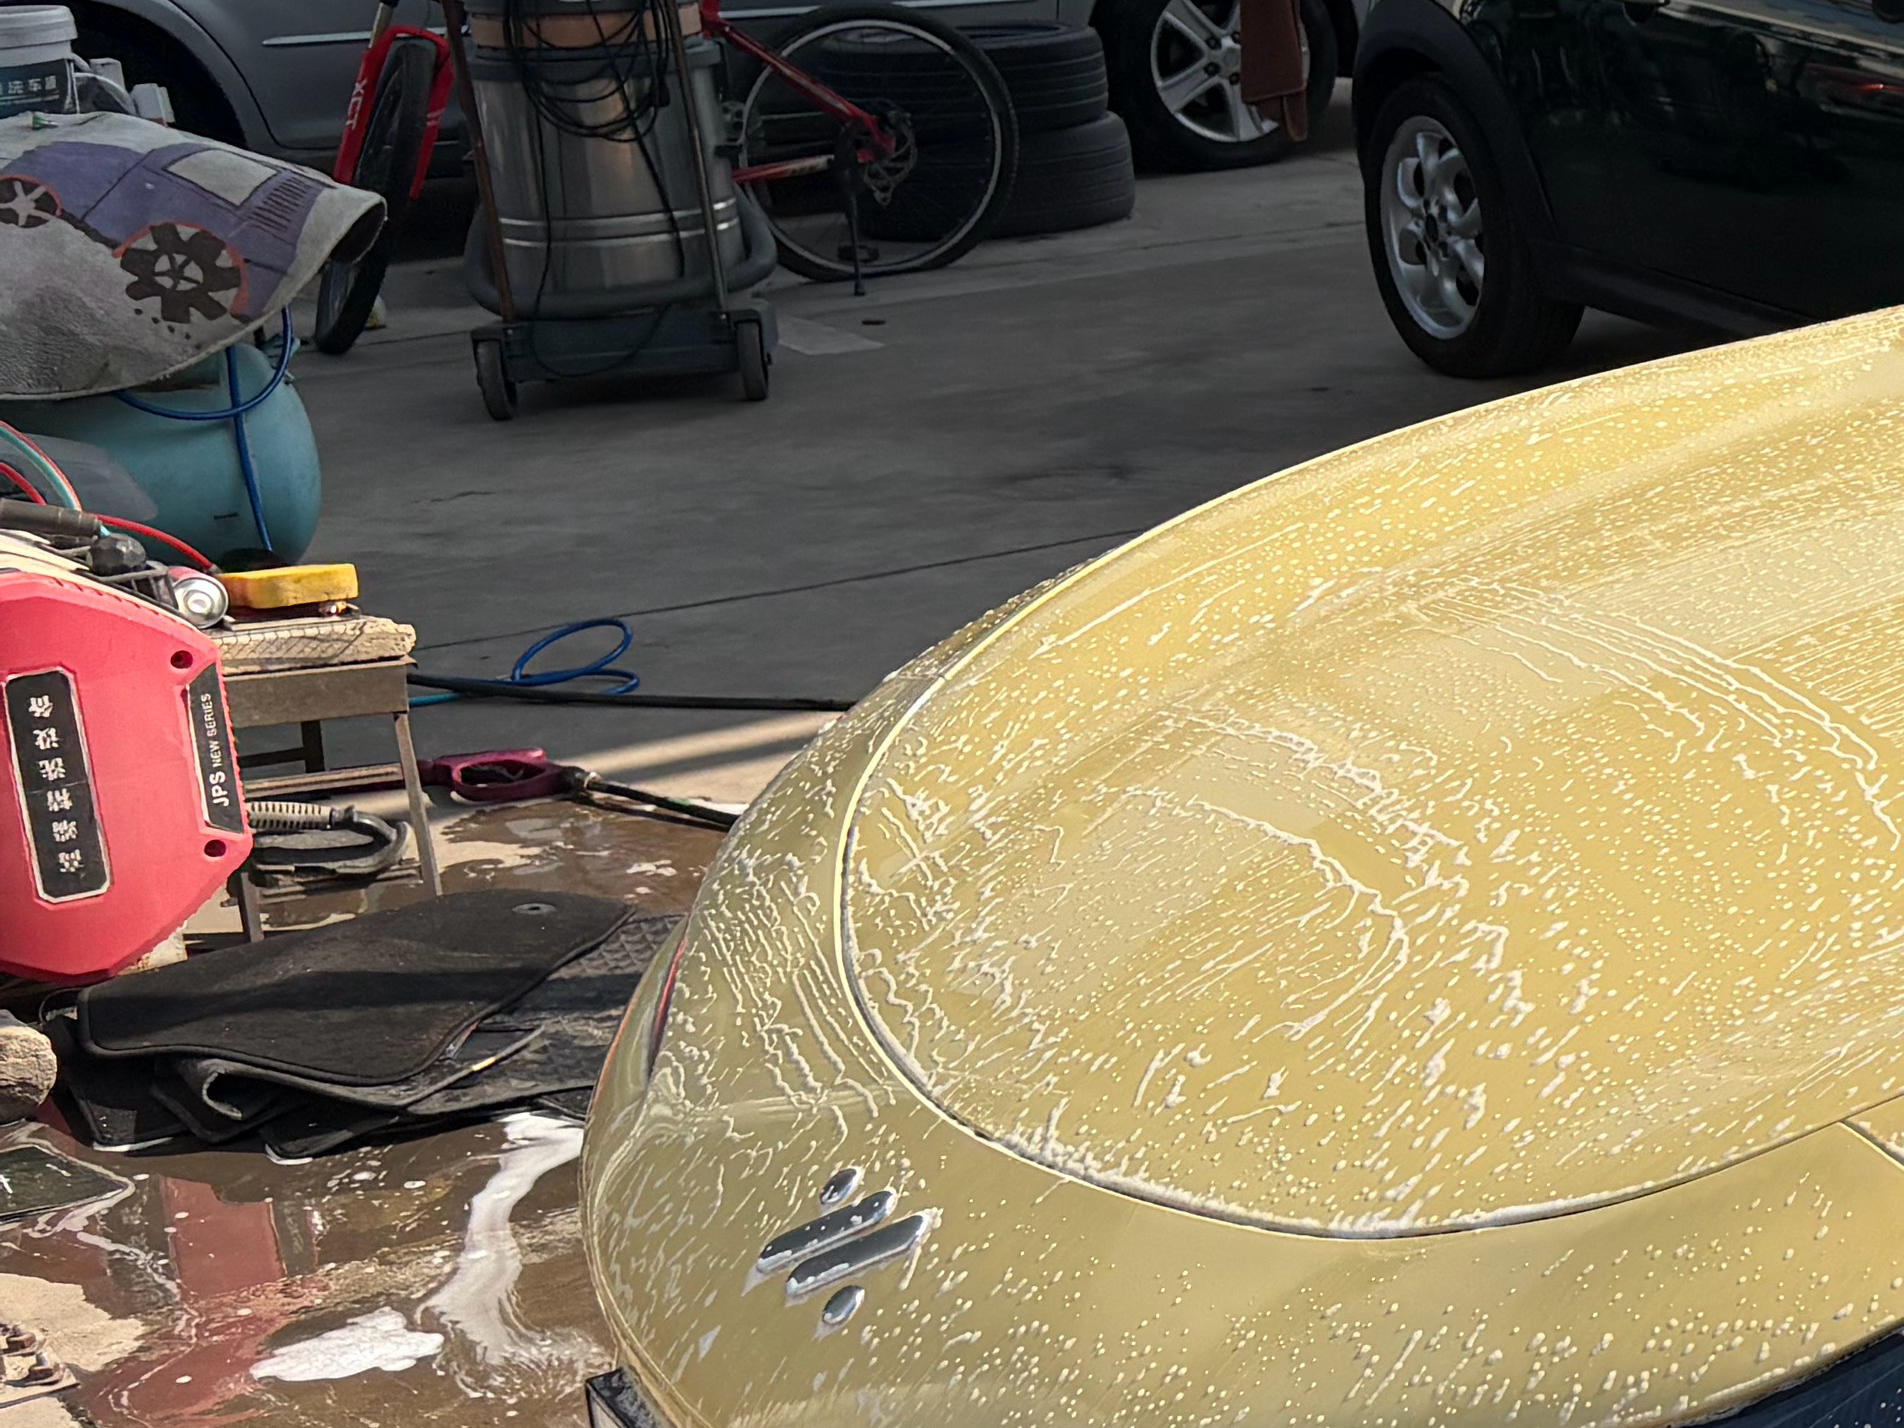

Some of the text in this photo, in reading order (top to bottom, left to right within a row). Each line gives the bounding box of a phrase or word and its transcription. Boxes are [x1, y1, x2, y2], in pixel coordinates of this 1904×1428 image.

[200, 692, 230, 807] JPS NEW SERIES
